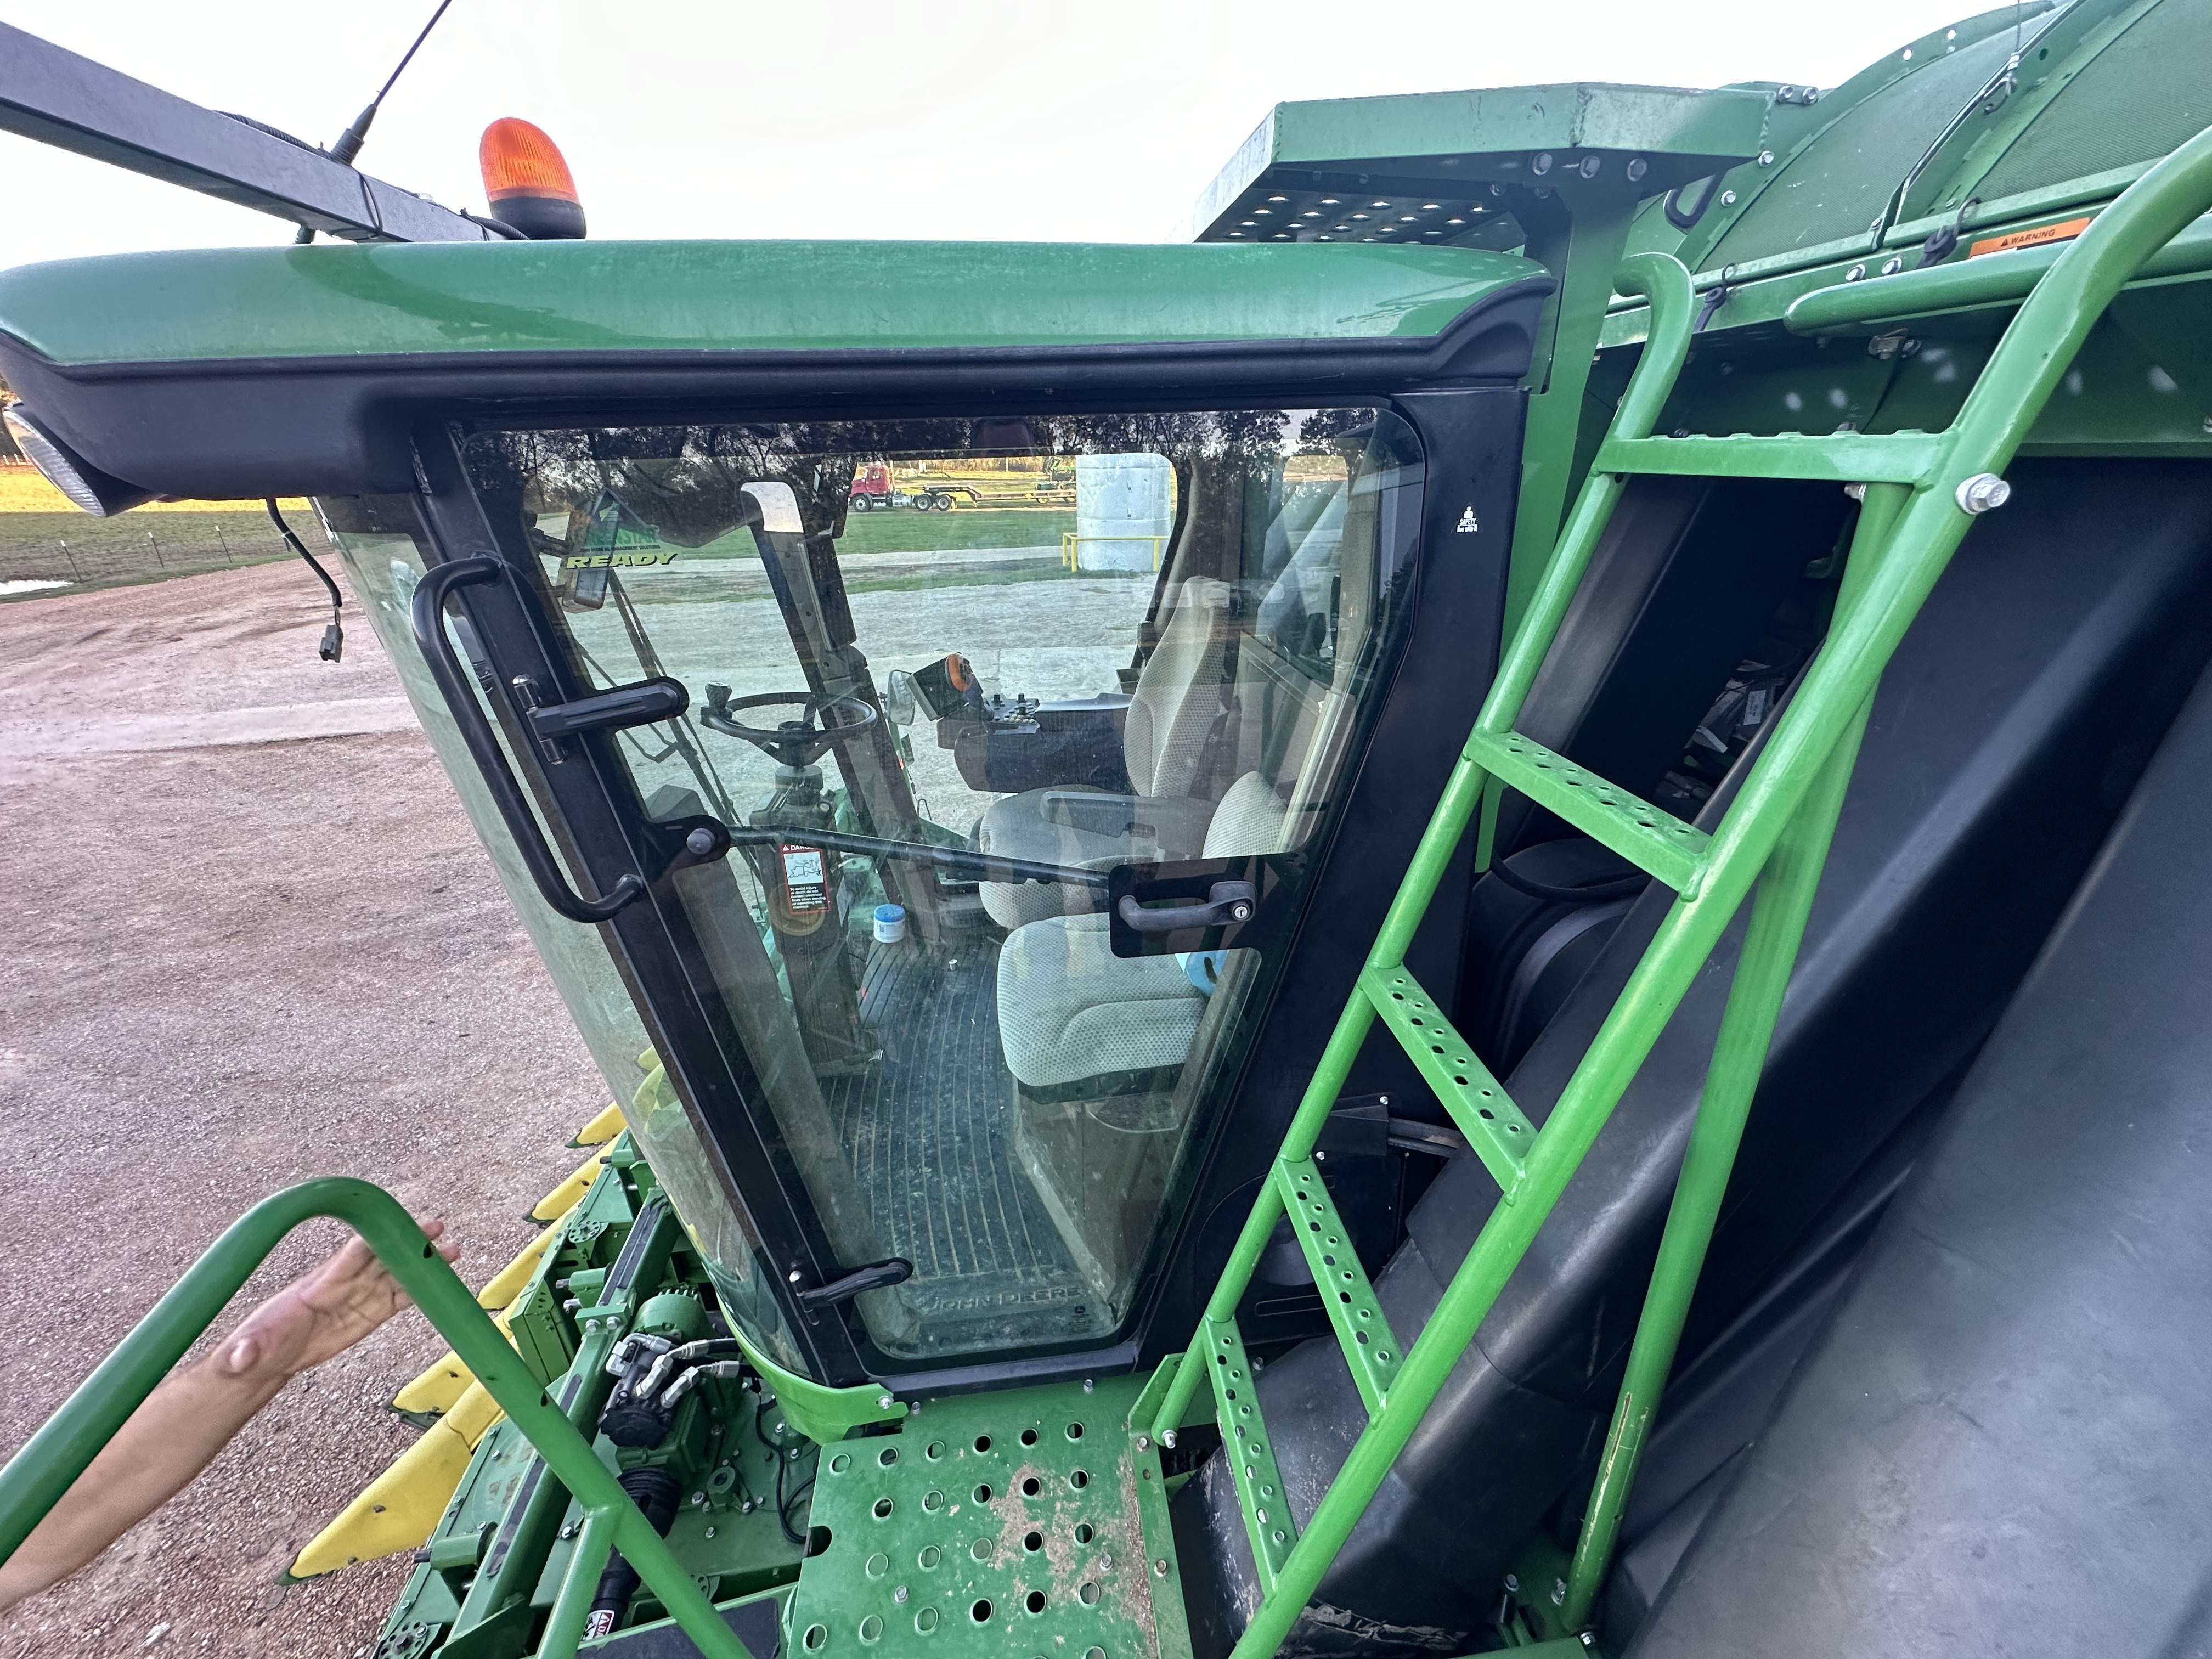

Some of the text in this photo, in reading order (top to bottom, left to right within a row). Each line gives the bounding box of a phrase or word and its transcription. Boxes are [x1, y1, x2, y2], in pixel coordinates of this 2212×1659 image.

[2011, 229, 2056, 244] WARNING
[566, 552, 679, 569] READY
[932, 1286, 1081, 1312] JOHN DEERE
